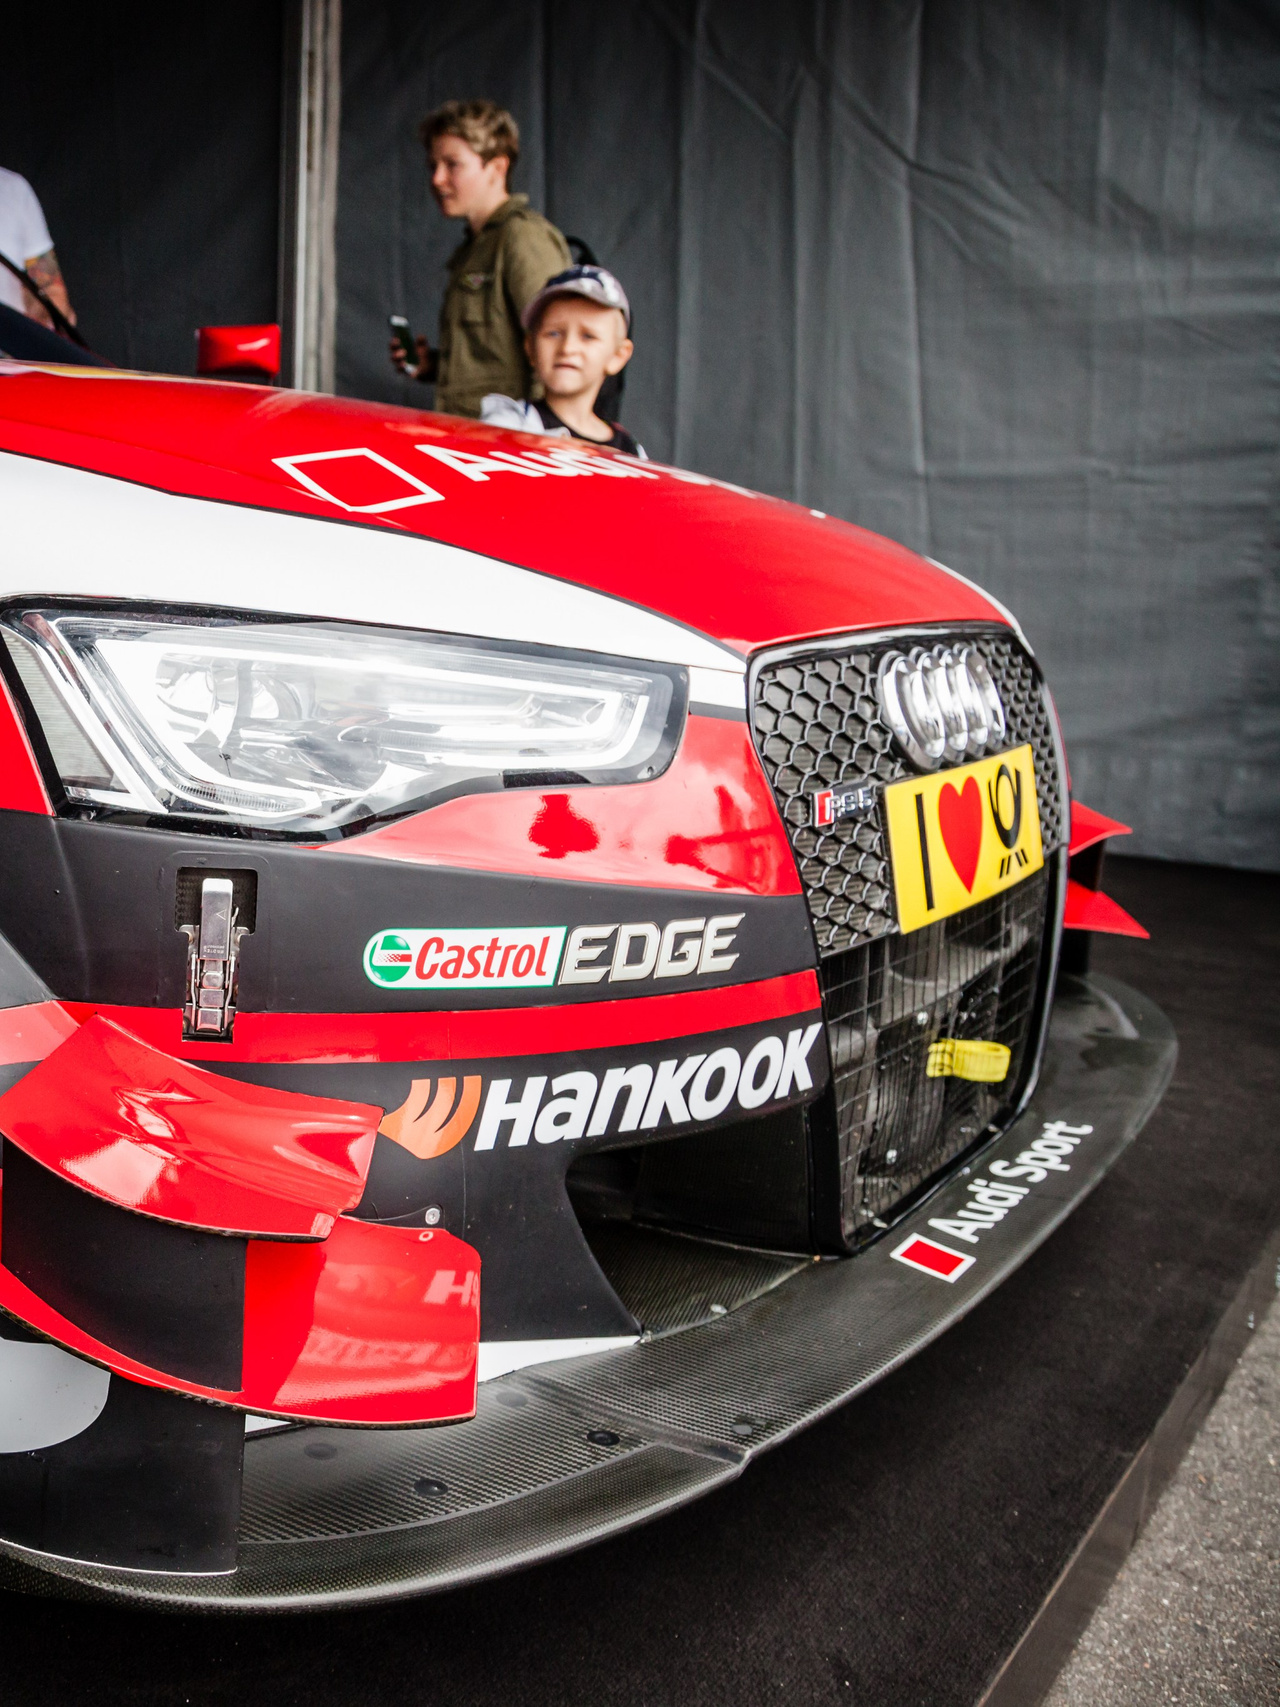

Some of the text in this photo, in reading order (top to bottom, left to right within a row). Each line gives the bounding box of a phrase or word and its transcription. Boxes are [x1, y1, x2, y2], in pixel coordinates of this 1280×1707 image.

[915, 792, 935, 912] I
[414, 912, 746, 986] Castrol EDGE
[927, 1120, 1094, 1245] Audi Sport
